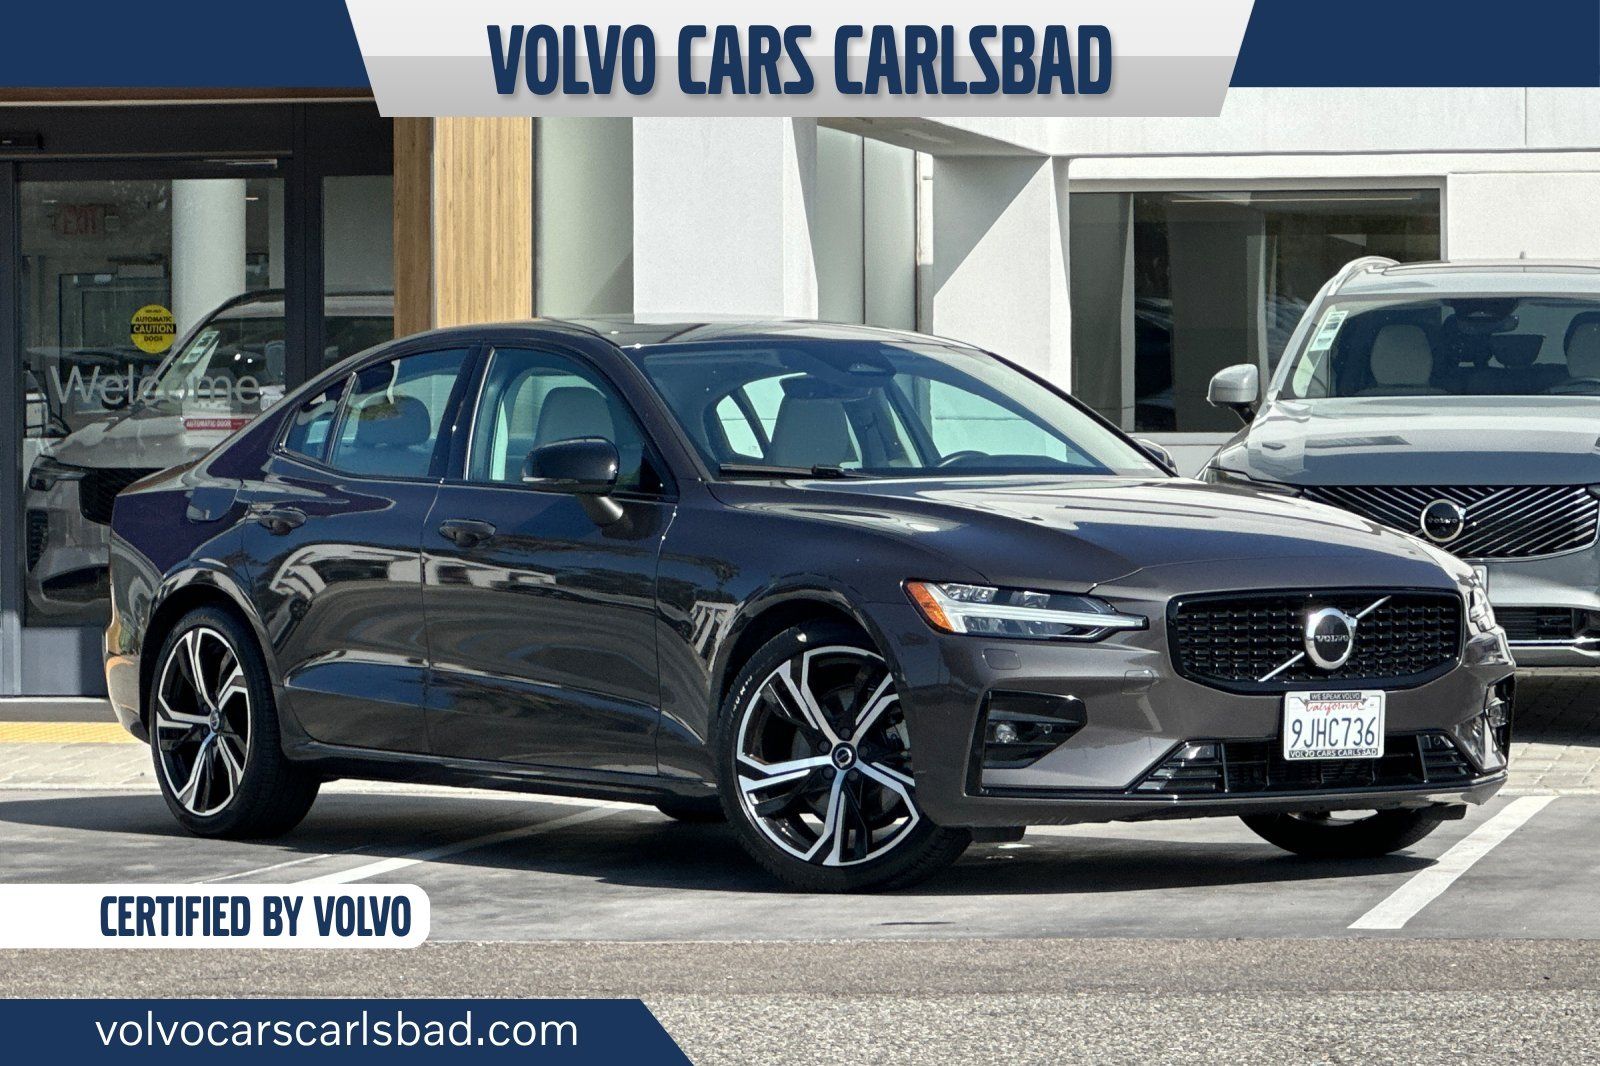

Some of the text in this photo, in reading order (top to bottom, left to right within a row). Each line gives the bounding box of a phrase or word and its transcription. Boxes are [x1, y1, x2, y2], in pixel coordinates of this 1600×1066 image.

[133, 324, 174, 333] CAUTION
[50, 364, 260, 405] Welcome
[1321, 692, 1341, 700] SPEAK
[1341, 692, 1361, 700] VOLVO
[1306, 701, 1365, 716] California
[1291, 716, 1377, 749] 9JHC736
[1316, 749, 1336, 757] CARS
